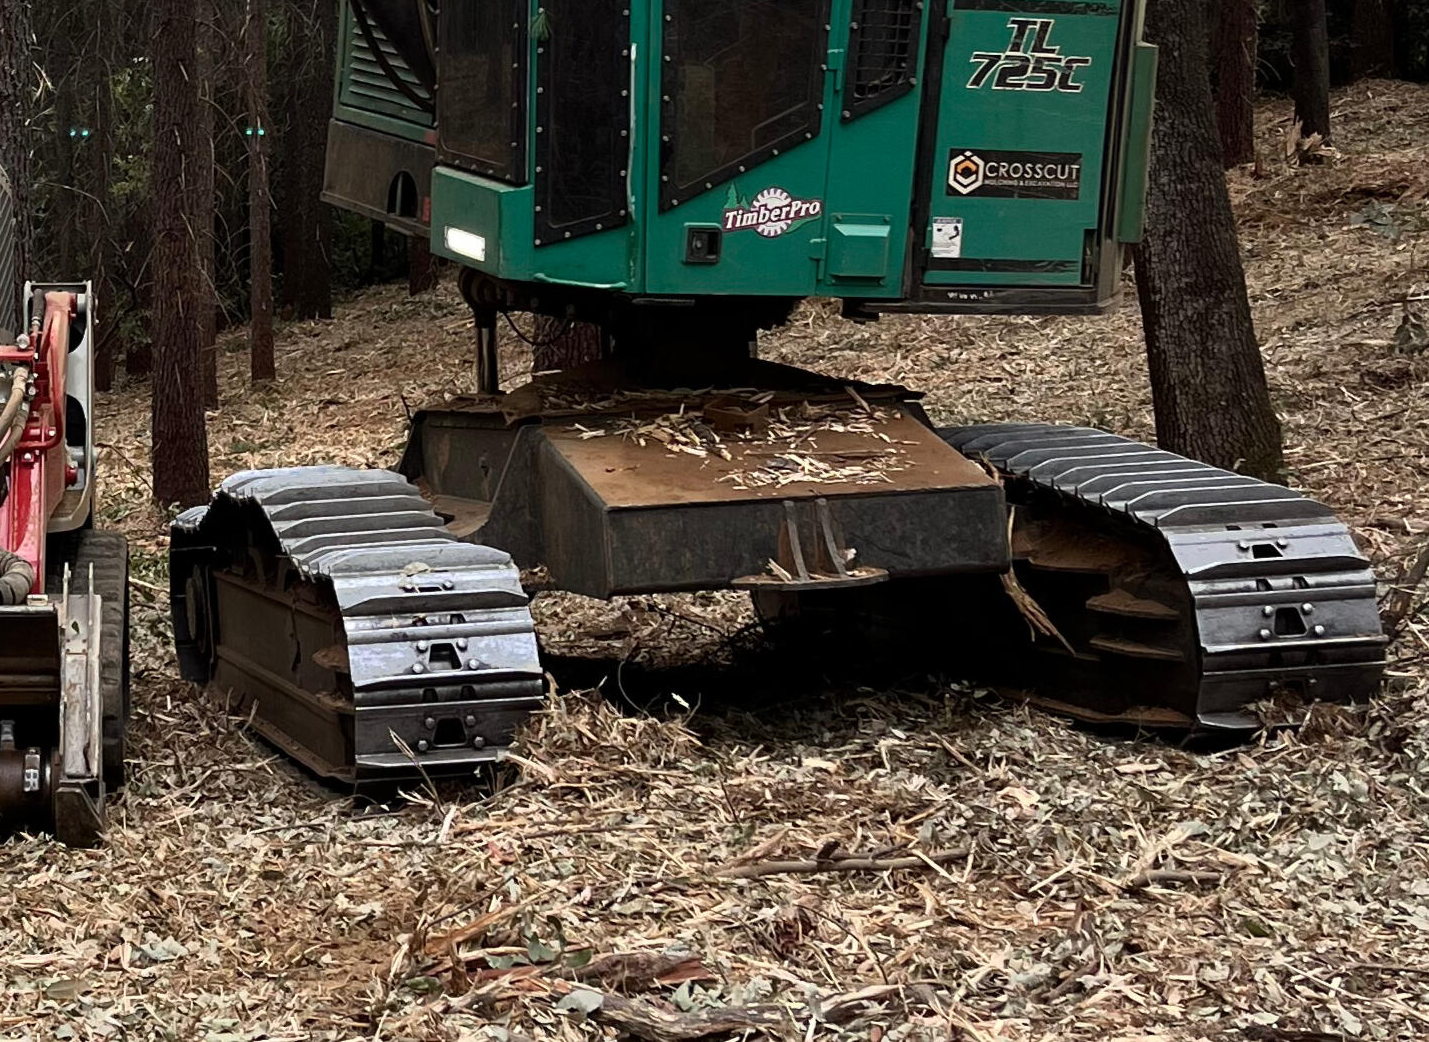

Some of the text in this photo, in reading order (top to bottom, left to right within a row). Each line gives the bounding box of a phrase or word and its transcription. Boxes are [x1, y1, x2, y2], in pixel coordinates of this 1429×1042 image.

[1006, 17, 1061, 55] TL
[966, 52, 1092, 93] 725C
[985, 162, 1081, 179] CROSSCUT
[724, 200, 821, 230] TimberPro
